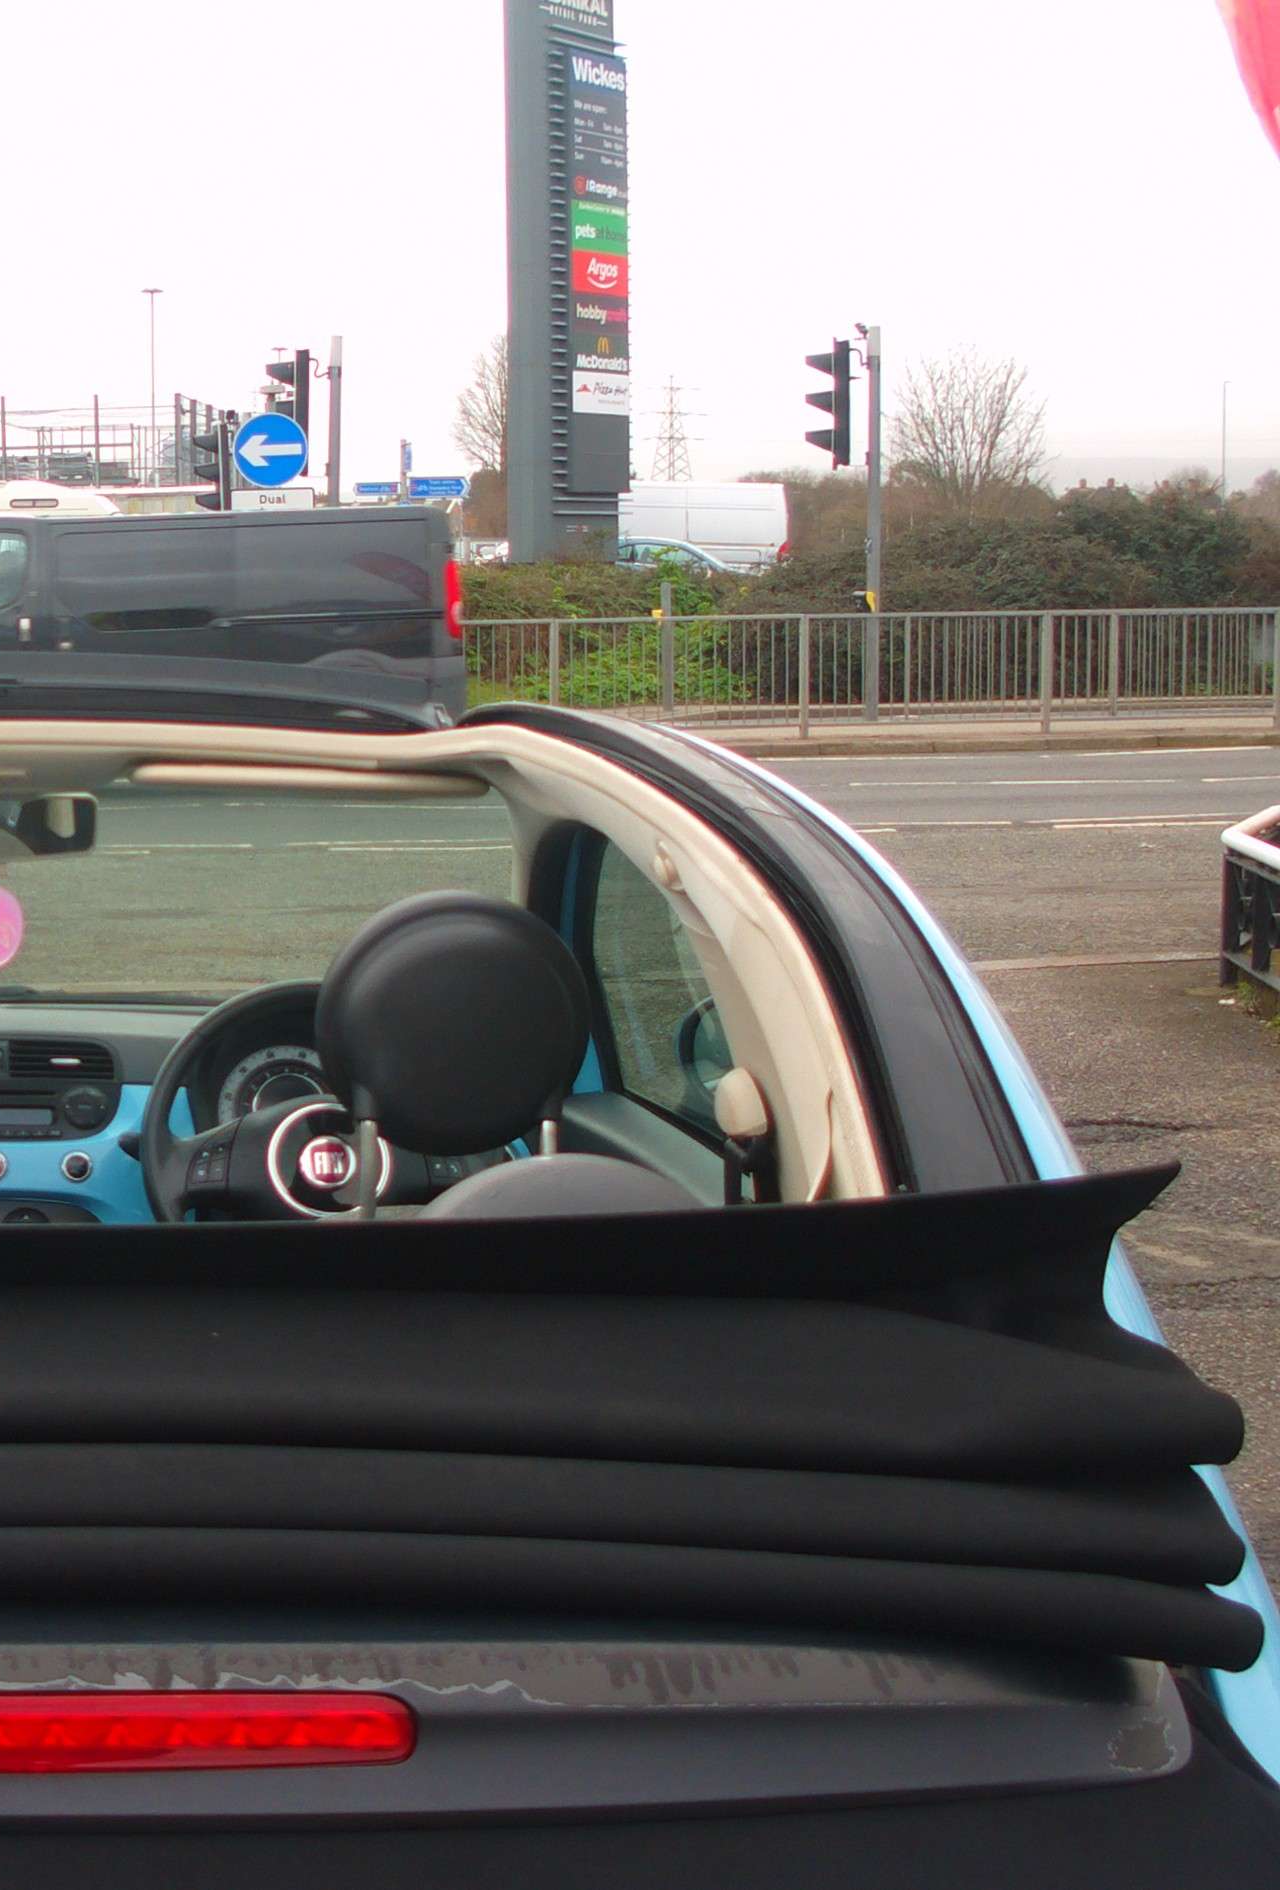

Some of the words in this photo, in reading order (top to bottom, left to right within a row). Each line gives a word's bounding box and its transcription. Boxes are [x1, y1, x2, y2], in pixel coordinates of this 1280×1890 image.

[572, 56, 625, 92] Wickes
[575, 223, 597, 240] pets
[587, 257, 619, 281] Argos
[259, 494, 286, 505] Dual
